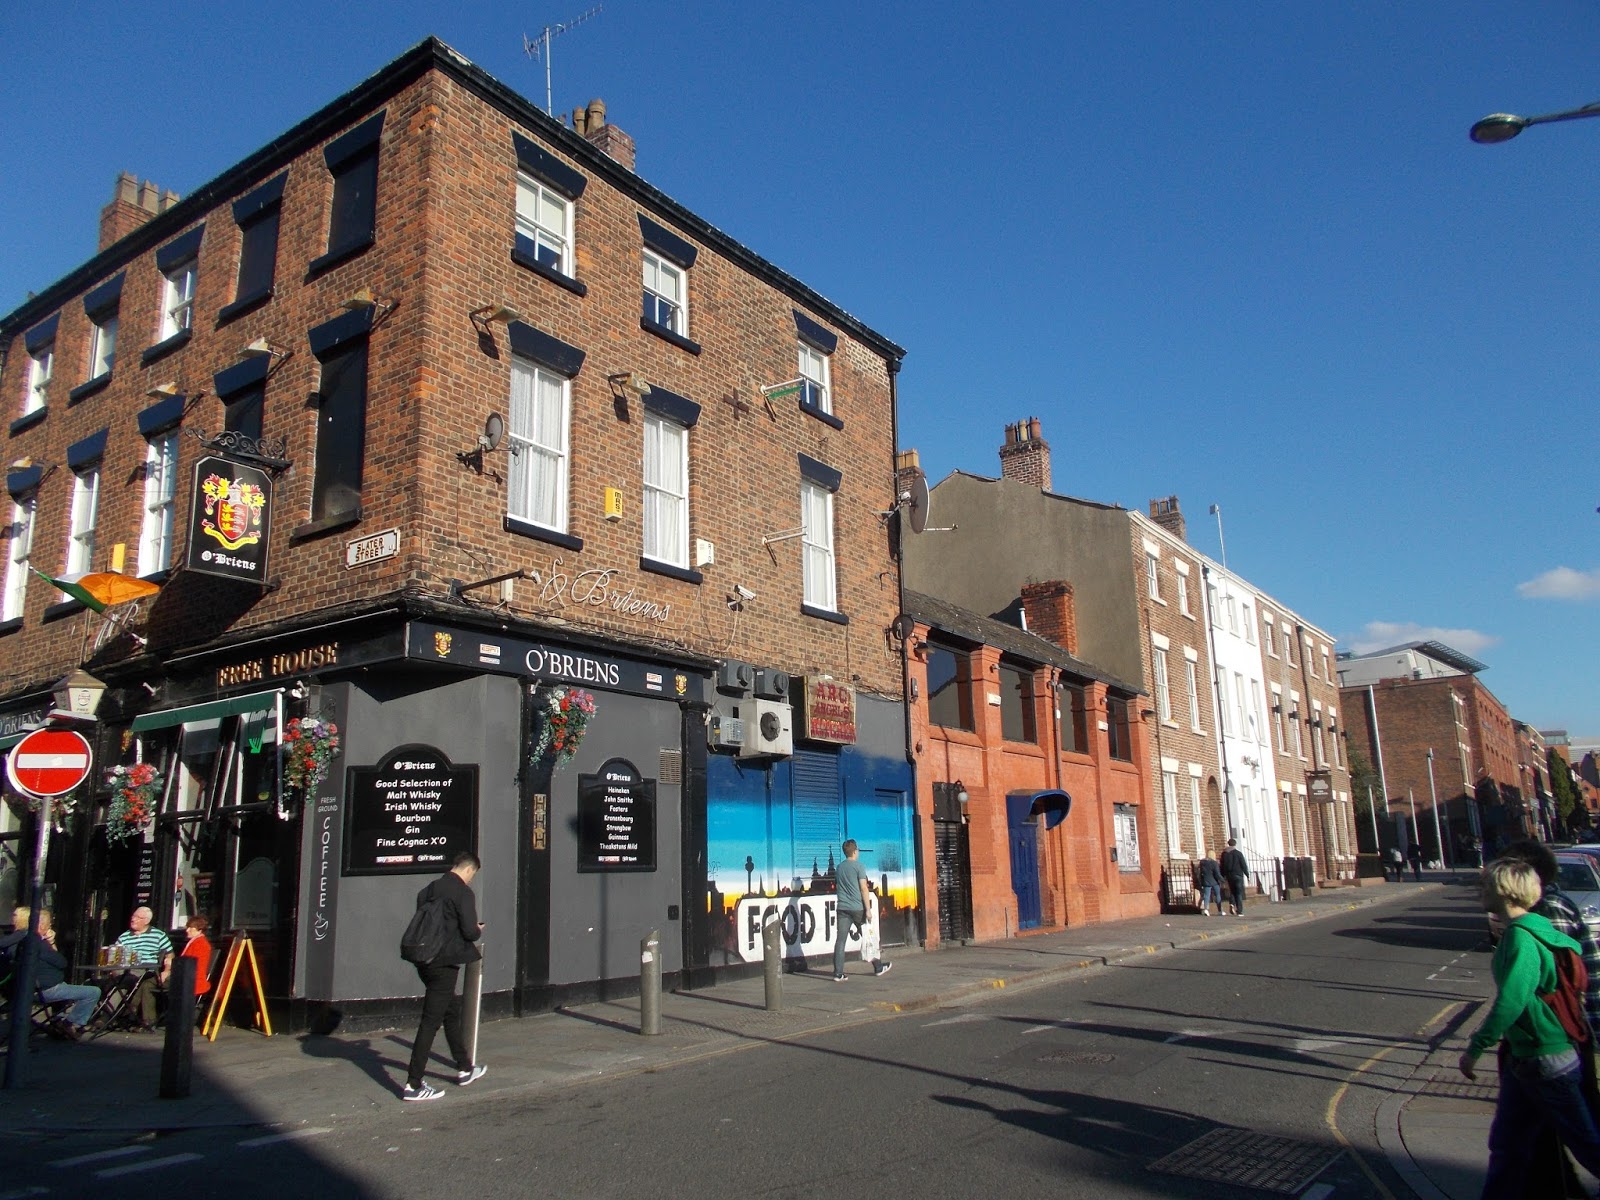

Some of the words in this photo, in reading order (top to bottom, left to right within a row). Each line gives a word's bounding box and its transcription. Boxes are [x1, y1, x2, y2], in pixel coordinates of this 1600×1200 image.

[357, 537, 384, 551] SLATER
[355, 546, 384, 562] STREET
[201, 550, 257, 570] O'Briens
[219, 658, 263, 687] FREE
[272, 641, 338, 675] HOUSE
[525, 649, 620, 685] O'BRIENS
[394, 761, 436, 770] O'Briens
[375, 780, 398, 788] Good
[400, 779, 441, 787] Selection
[442, 779, 452, 787] of
[386, 791, 407, 799] Malt
[409, 790, 441, 800] Whisky
[320, 796, 336, 804] FRESH
[318, 804, 338, 813] GROUND
[384, 803, 407, 811] Irish
[410, 802, 442, 811] Whisky
[395, 814, 431, 822] Bourbon
[603, 815, 634, 823] Kronenbourg
[405, 826, 420, 834] Gin
[606, 824, 632, 832] Strongbow
[608, 833, 629, 841] Guinness
[376, 838, 396, 847] Fine
[398, 838, 429, 847] Cognac
[319, 816, 331, 908] COFFEE
